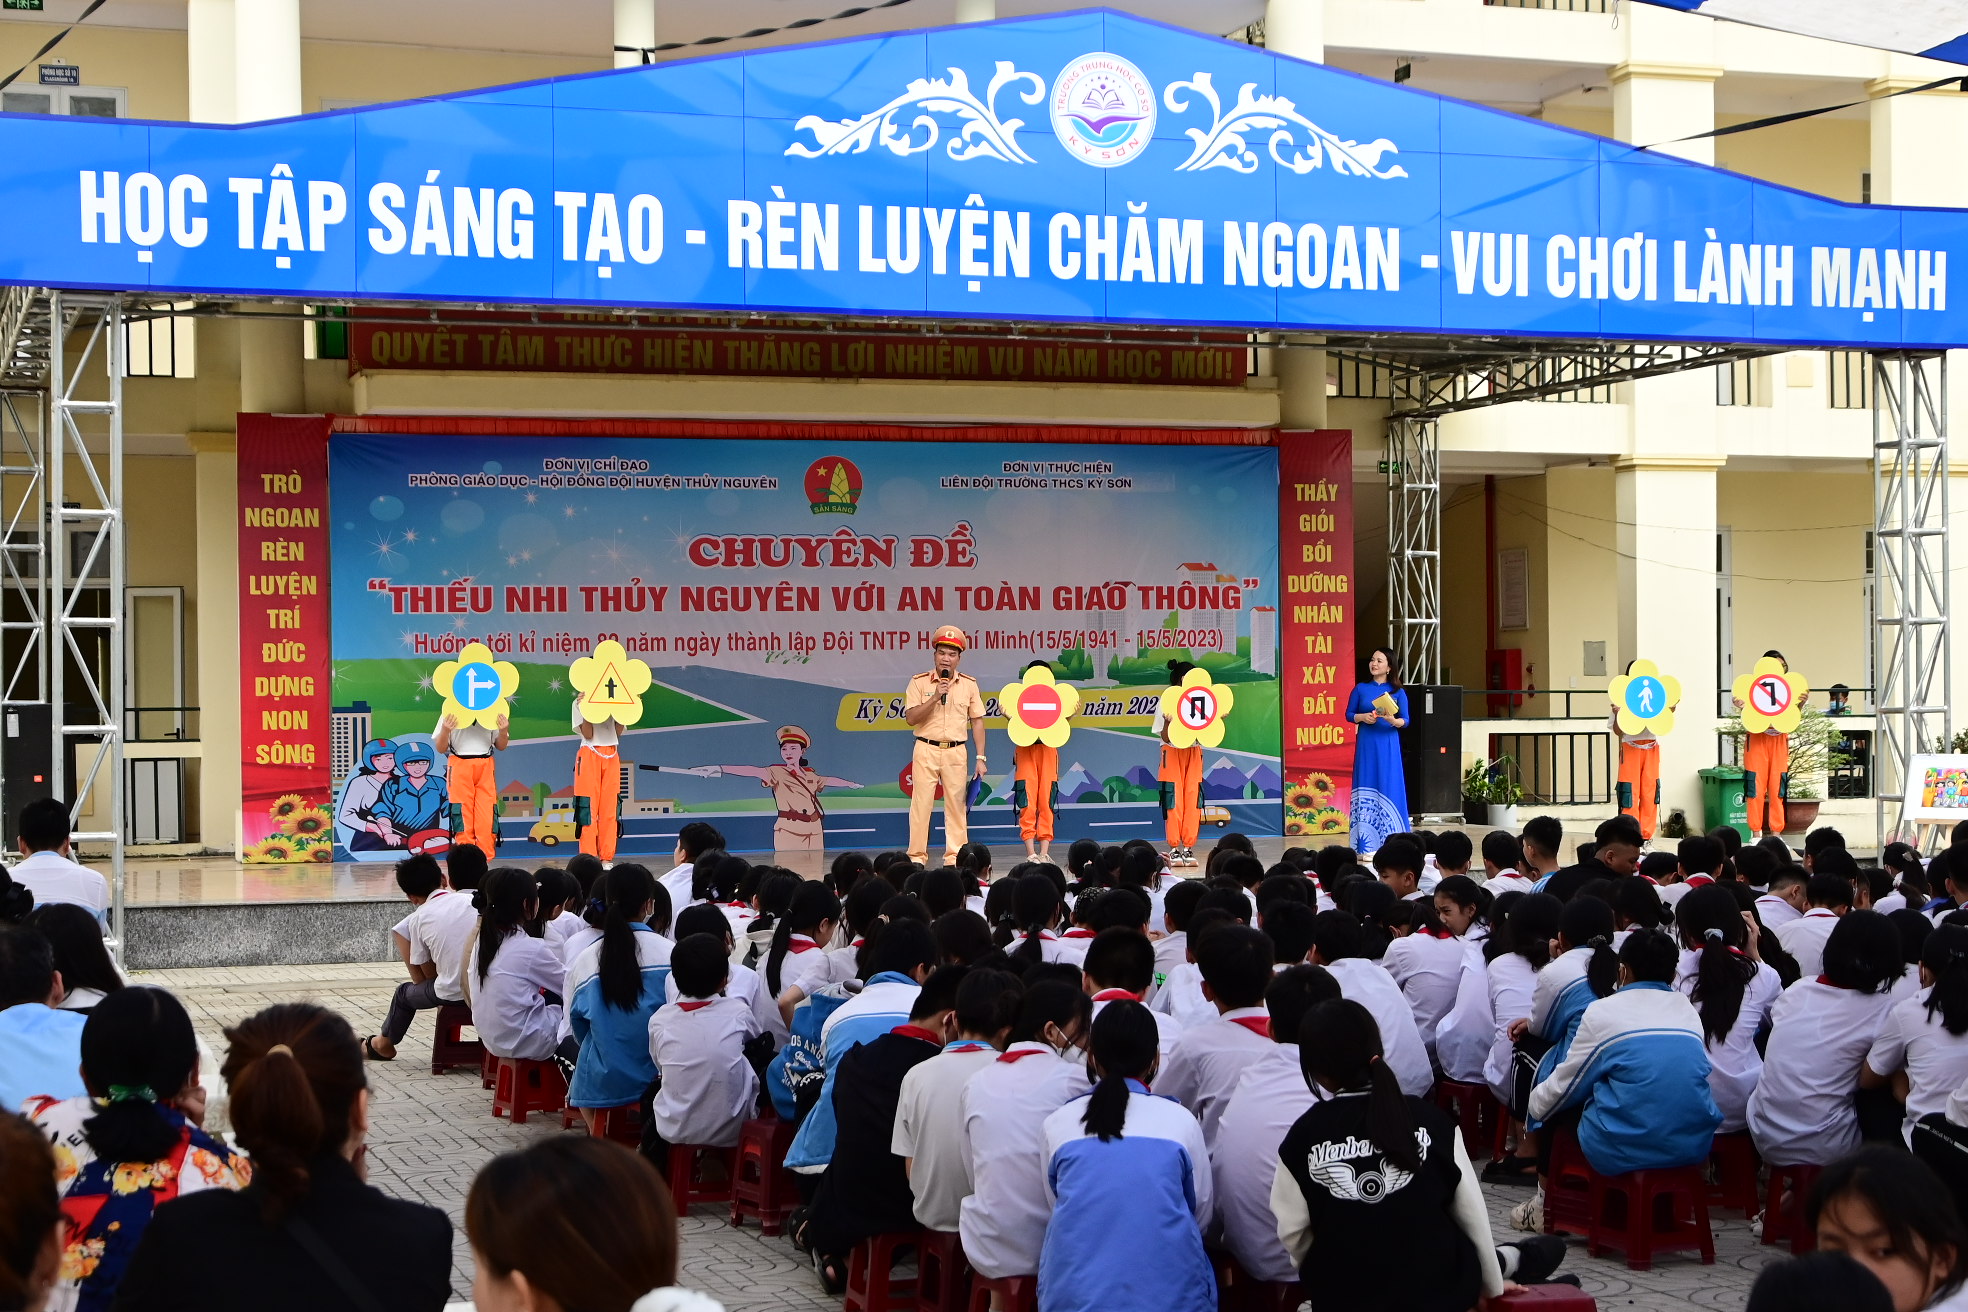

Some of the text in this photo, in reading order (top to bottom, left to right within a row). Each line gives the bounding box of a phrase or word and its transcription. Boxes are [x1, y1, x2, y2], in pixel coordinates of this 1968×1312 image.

[80, 171, 208, 263] HỌC
[229, 163, 347, 269] TẬP
[368, 169, 534, 259] SÁNG
[555, 192, 664, 278] TẠO
[727, 186, 839, 271] RÈN
[858, 193, 1030, 292] LUYỆN
[1048, 201, 1204, 285] CHĂM
[1224, 221, 1400, 292] NGOAN
[1451, 230, 1529, 297] VUI
[1546, 231, 1658, 301] CHƠI
[1674, 228, 1794, 306] LÀNH
[1811, 246, 1947, 322] MẠNH
[371, 325, 468, 365] QUYẾT
[478, 328, 545, 366] TÂM
[555, 333, 632, 374] THỰC
[644, 333, 714, 375] HIỆN
[988, 346, 1024, 381] VỤ
[1034, 341, 1098, 377] NĂM
[1107, 348, 1162, 383] HỌC
[1172, 345, 1232, 379] MỚI!
[545, 457, 649, 473] ĐƠN VỊ CHỈ ĐẠO
[1003, 461, 1112, 475] ĐƠN VỊ THỰC HIỆN
[261, 469, 302, 494] TRÒ
[410, 473, 458, 486] PHÒNG
[463, 473, 496, 486] GIÁO
[500, 476, 528, 489] DỤC
[540, 475, 563, 489] HỘI
[567, 473, 605, 487] ĐỒNG
[609, 475, 632, 490] ĐỘI
[636, 475, 681, 490] HUYỆN
[685, 474, 719, 488] THỦY
[723, 476, 777, 488] NGUYÊN
[941, 476, 1132, 490] LIÊN ĐỘI TRƯỜNG THCS KỲ SƠN
[245, 507, 320, 528] NGOAN
[1299, 508, 1335, 532] GIỎI
[261, 537, 305, 561] RÈN
[688, 523, 976, 568] CHUYÊN ĐỀ
[1302, 538, 1332, 563] BỒI
[249, 571, 317, 600] LUYỆN
[1287, 570, 1348, 593] DƯỠNG
[505, 586, 568, 612] NHI
[580, 577, 668, 612] THỦY
[680, 581, 820, 612] NGUYÊN
[831, 581, 885, 612] VỚI
[897, 586, 944, 612] AN
[954, 580, 1041, 611] TOÀN
[1052, 585, 1127, 611] GIAO
[266, 605, 301, 629] TRÍ
[1293, 601, 1343, 624] NHÂN
[262, 639, 306, 663] ĐỨC
[487, 632, 512, 653] tới
[519, 630, 536, 653] kỉ
[542, 632, 589, 656] niệm
[626, 632, 667, 652] năm
[674, 631, 721, 657] ngày
[727, 631, 781, 651] thành
[788, 632, 816, 656] lập
[823, 631, 853, 655] Đội
[860, 631, 910, 650] TNTP
[917, 631, 930, 650] H
[1137, 630, 1224, 652] 15/5/2023)
[1305, 632, 1332, 654] TÀI
[1302, 662, 1336, 684] XÂY
[255, 675, 315, 701] DỰNG
[854, 699, 884, 724] Kỳ
[1082, 696, 1123, 716] năm
[1126, 696, 1160, 715] 202
[1302, 690, 1336, 715] ĐẤT
[262, 710, 308, 730] NON
[1296, 723, 1344, 747] NƯỚC
[256, 740, 315, 765] SÔNG
